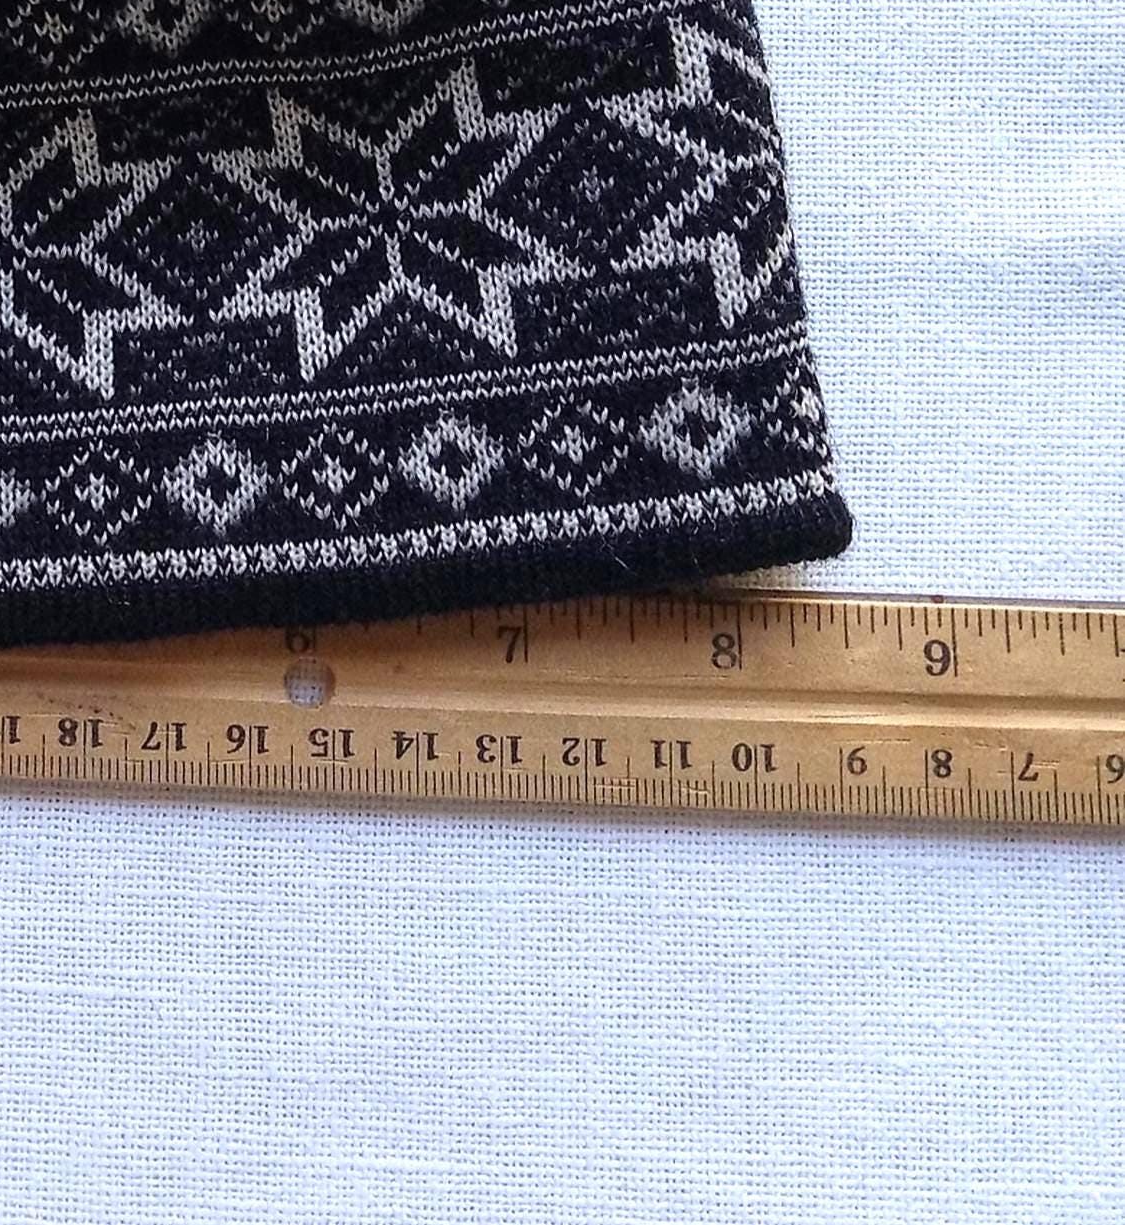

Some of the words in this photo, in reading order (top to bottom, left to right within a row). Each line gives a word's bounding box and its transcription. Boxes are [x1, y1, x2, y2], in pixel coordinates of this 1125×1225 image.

[497, 626, 523, 664] 7
[711, 633, 737, 670] 8
[923, 638, 951, 677] 9
[58, 718, 103, 748] 18
[141, 721, 187, 751] 17
[226, 725, 270, 754] 16
[308, 728, 355, 758] 15
[392, 731, 439, 761] 14
[476, 735, 524, 764] 13
[562, 737, 608, 767] 12
[650, 739, 693, 770] 11
[732, 742, 778, 773] 10
[847, 746, 867, 775] 9
[931, 749, 952, 778] 8
[1017, 752, 1039, 782] 7
[1106, 754, 1125, 784] 6
